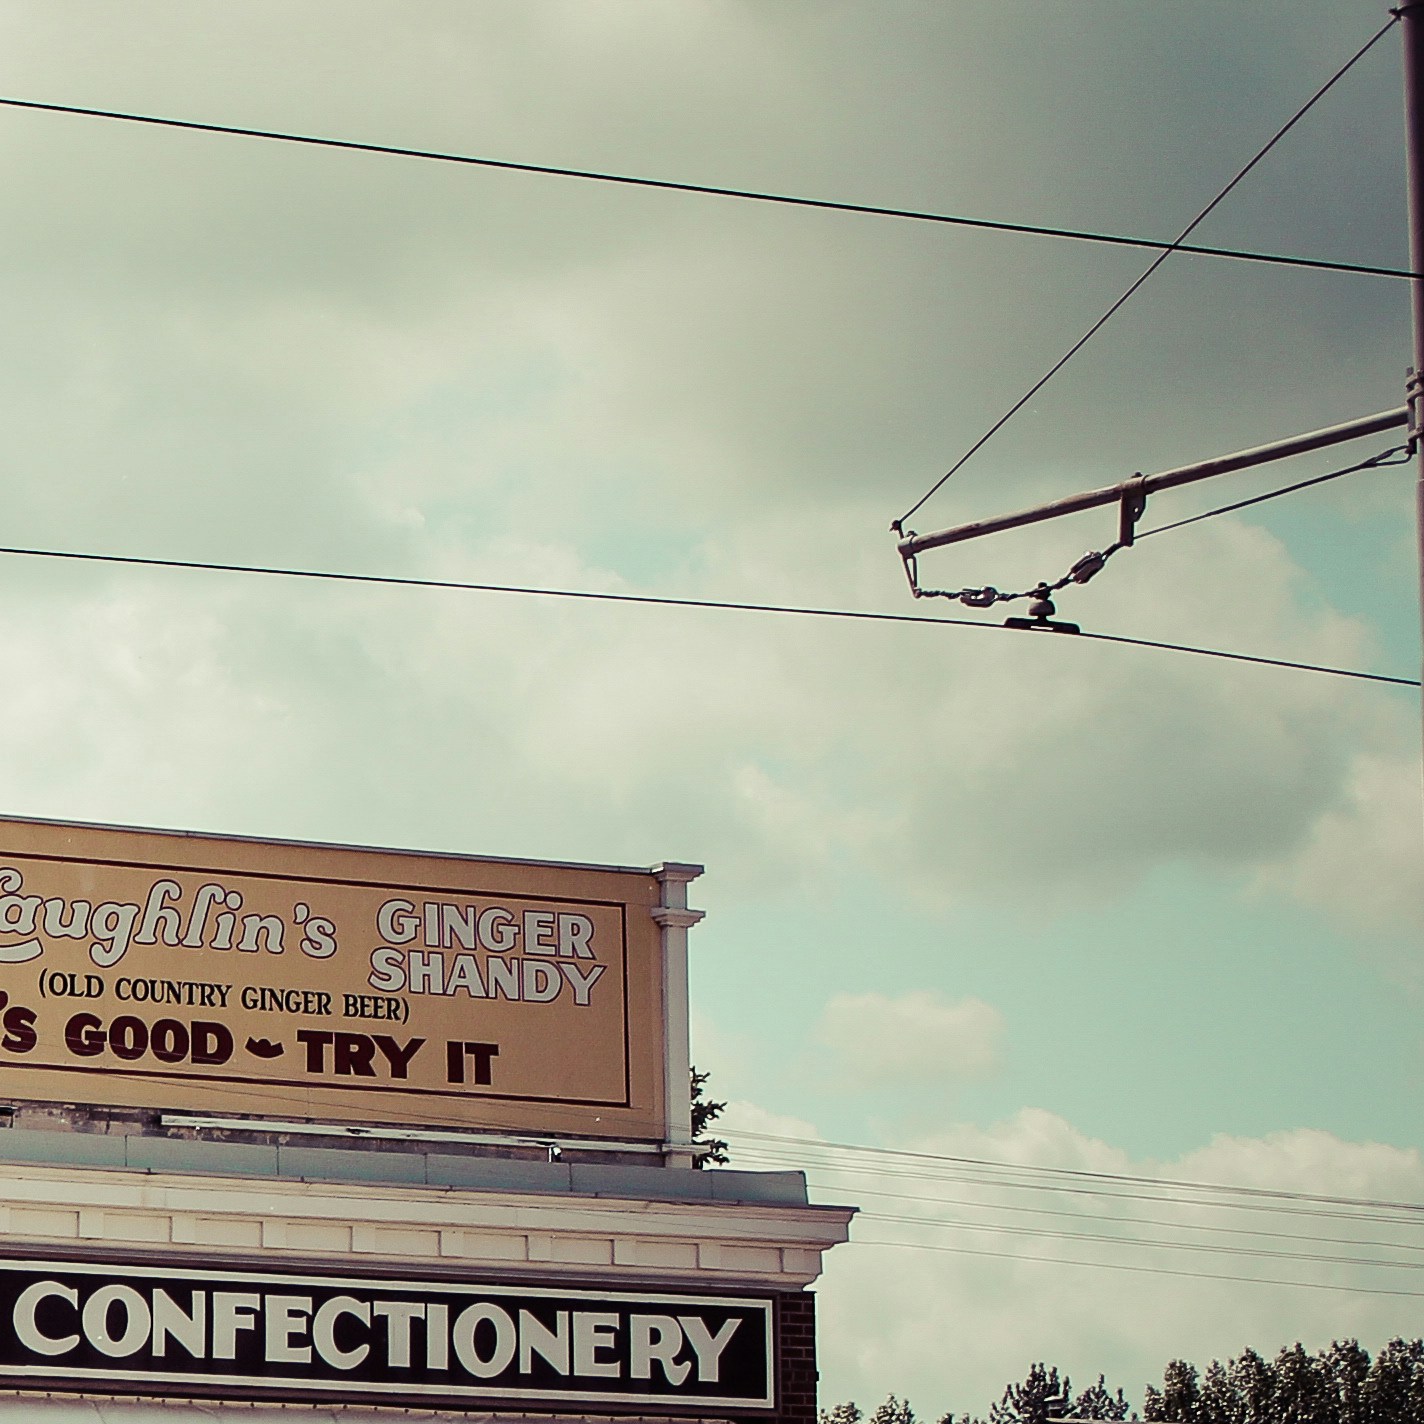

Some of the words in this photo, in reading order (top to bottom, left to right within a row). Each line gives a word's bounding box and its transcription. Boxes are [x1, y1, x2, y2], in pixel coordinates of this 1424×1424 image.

[374, 898, 595, 961] GINGER
[38, 967, 104, 999] (OLD
[114, 977, 232, 1009] COUNTRY
[240, 986, 332, 1016] GINGER
[343, 992, 410, 1026] BEER)
[368, 947, 606, 1007] SHANDY
[66, 1014, 234, 1065] GOOD
[296, 1029, 424, 1079] TRY
[446, 1041, 499, 1086] IT
[13, 1279, 743, 1388] CONFECTIONERY
